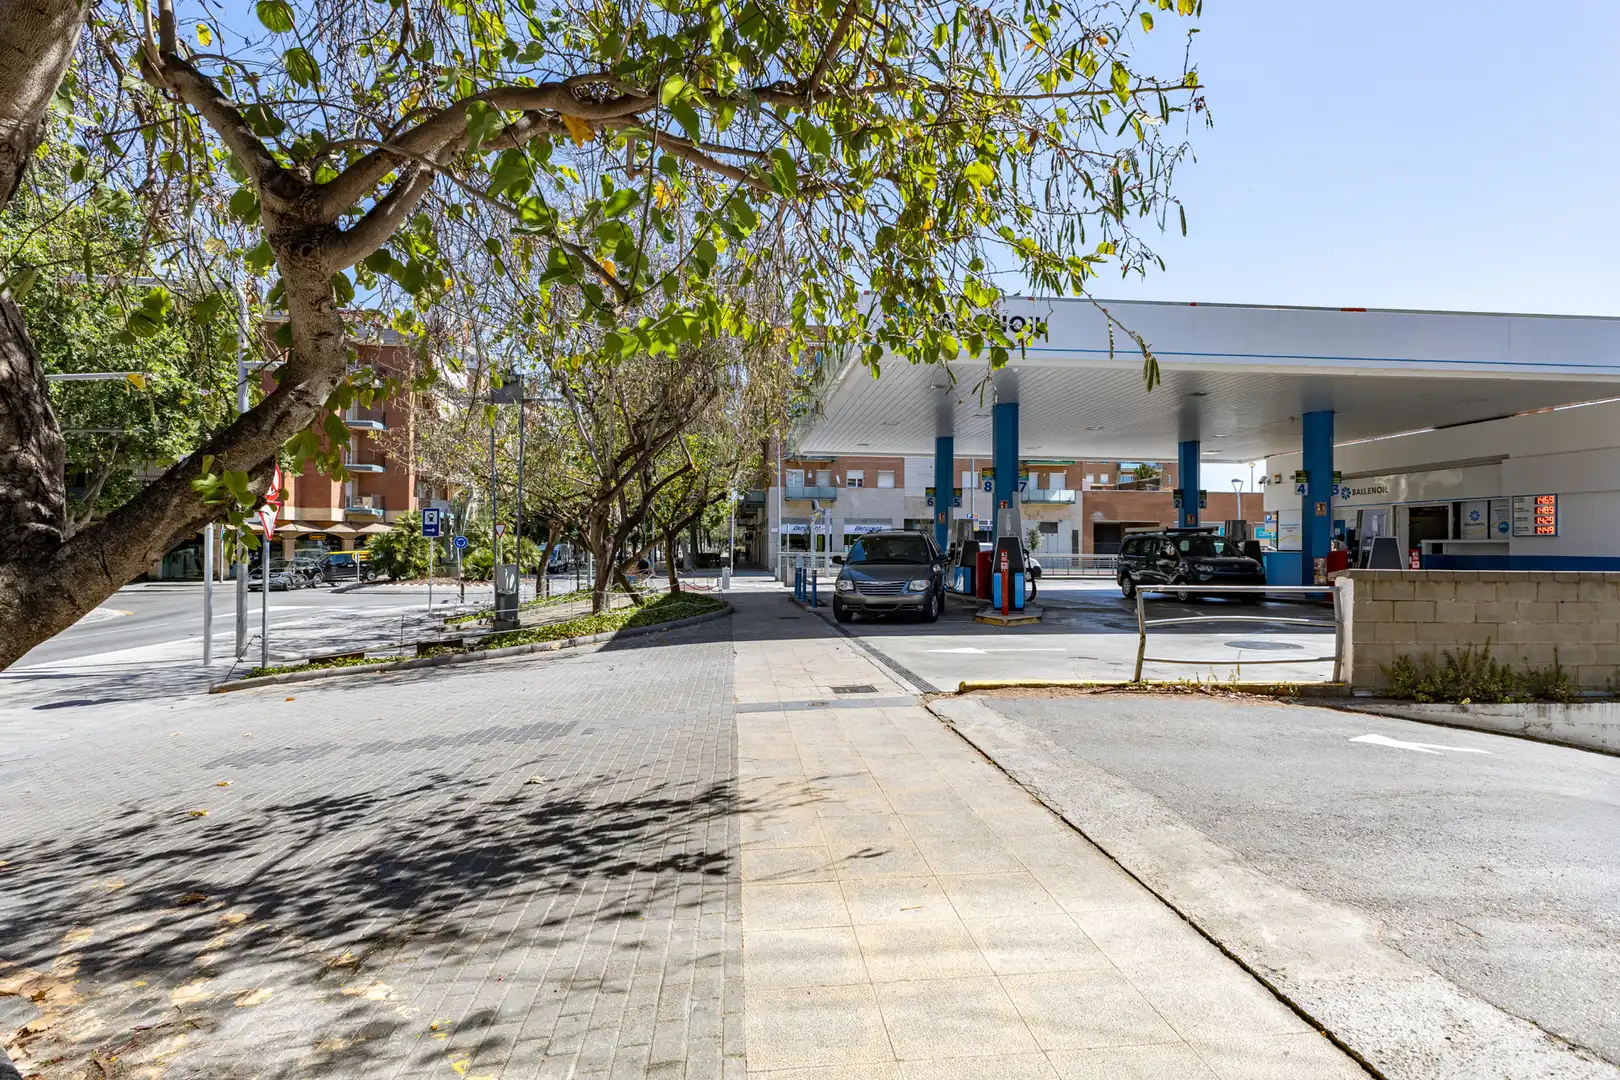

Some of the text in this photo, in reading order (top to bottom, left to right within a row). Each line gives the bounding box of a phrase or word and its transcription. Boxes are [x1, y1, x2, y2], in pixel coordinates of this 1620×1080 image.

[984, 481, 992, 492] 8
[1019, 481, 1027, 492] 7
[1297, 484, 1305, 495] 4
[1332, 484, 1339, 495] 3
[1352, 486, 1388, 496] BALLENOIL
[927, 497, 934, 507] 6
[954, 498, 960, 507] 5
[1175, 499, 1181, 508] 2
[1199, 499, 1205, 508] 1
